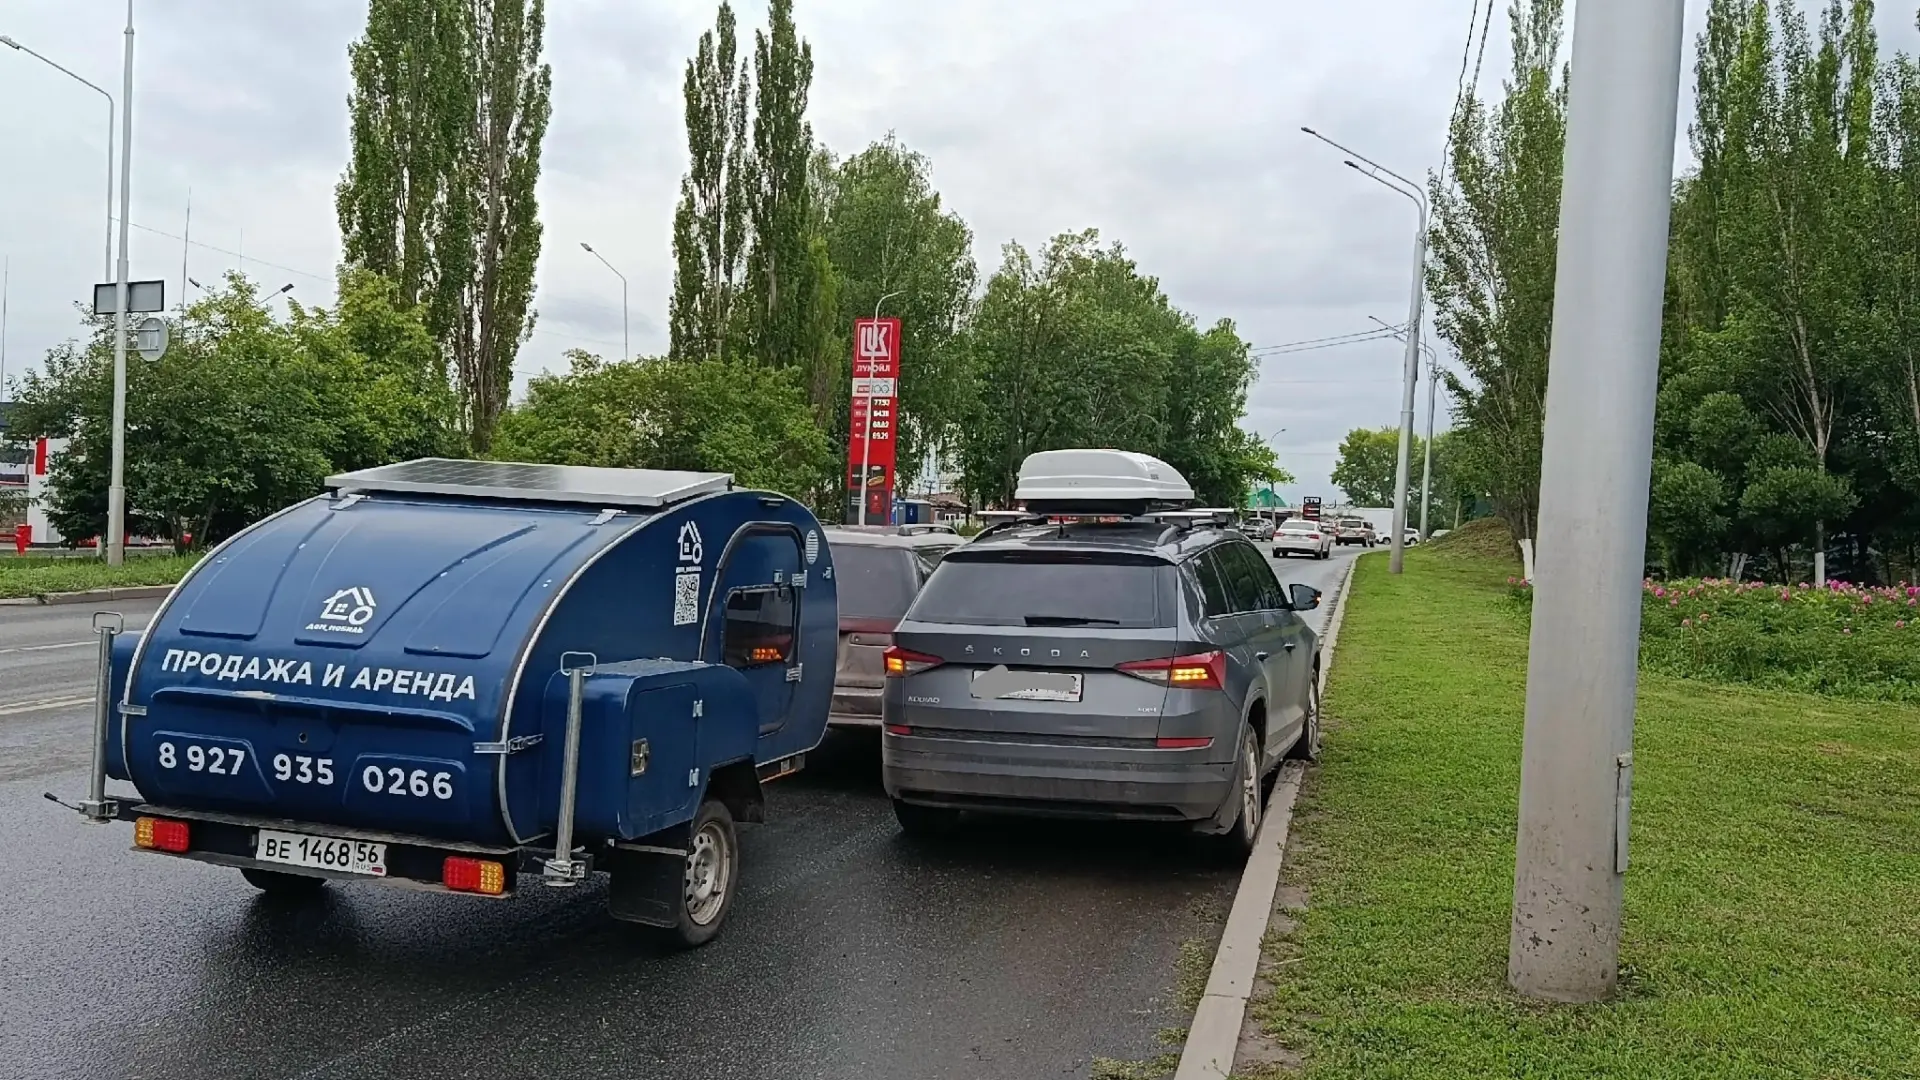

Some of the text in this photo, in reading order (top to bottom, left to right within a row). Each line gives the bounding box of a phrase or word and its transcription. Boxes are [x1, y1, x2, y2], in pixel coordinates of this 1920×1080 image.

[856, 364, 890, 373] ЛУКОЙЛ
[161, 648, 476, 702] ПРОДАЖА И АРЕНДА
[159, 742, 453, 800] 8 927 935 0266
[298, 838, 350, 866] 1468
[357, 843, 378, 863] 56
